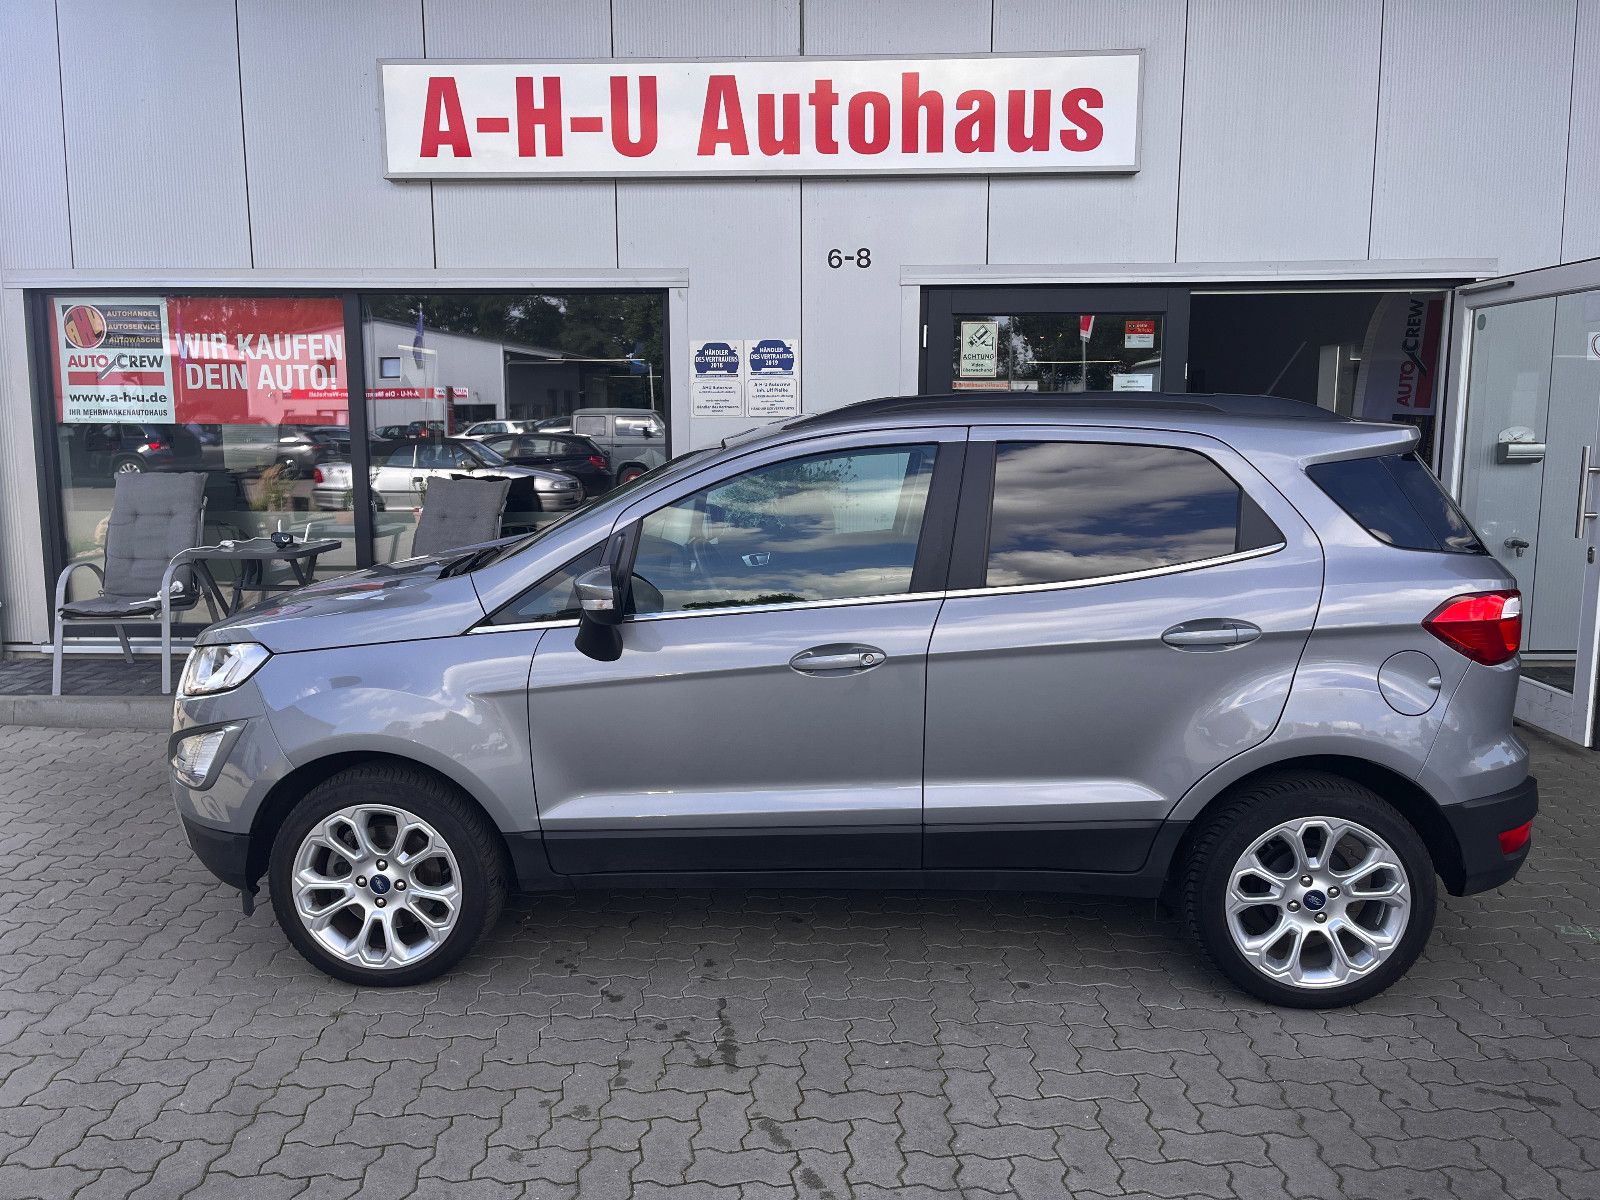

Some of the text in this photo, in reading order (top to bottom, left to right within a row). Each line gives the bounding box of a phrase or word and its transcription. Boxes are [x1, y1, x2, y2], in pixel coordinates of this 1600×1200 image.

[420, 71, 1105, 158] A-H-U Autohaus
[828, 248, 871, 268] 6-8
[175, 333, 343, 361] WIR KAUFEN
[1396, 298, 1424, 408] AUTO CREW
[68, 353, 164, 369] AUTO CREW
[185, 363, 337, 391] DEIN AUTO!
[68, 392, 167, 403] www.a-h-u.de
[83, 409, 168, 417] MEHRMARKENAUTOHAUS
